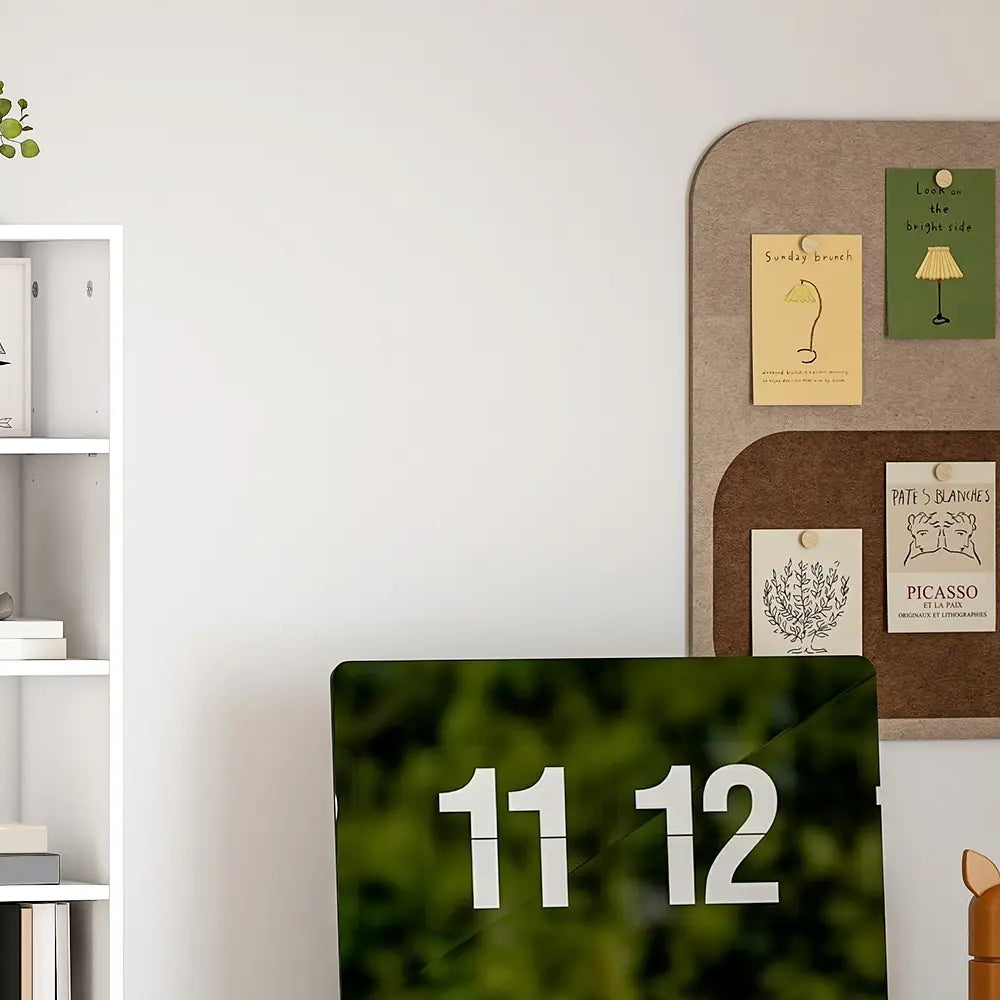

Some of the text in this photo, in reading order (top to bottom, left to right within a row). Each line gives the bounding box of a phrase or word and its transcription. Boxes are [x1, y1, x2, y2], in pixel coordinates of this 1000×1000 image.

[916, 182, 945, 195] Look
[930, 203, 949, 214] the
[906, 220, 972, 234] bright side
[765, 249, 852, 264] Sunday brunch
[934, 488, 991, 505] BLANCHES
[907, 585, 978, 600] PICASSO
[438, 763, 780, 910] 11 12
